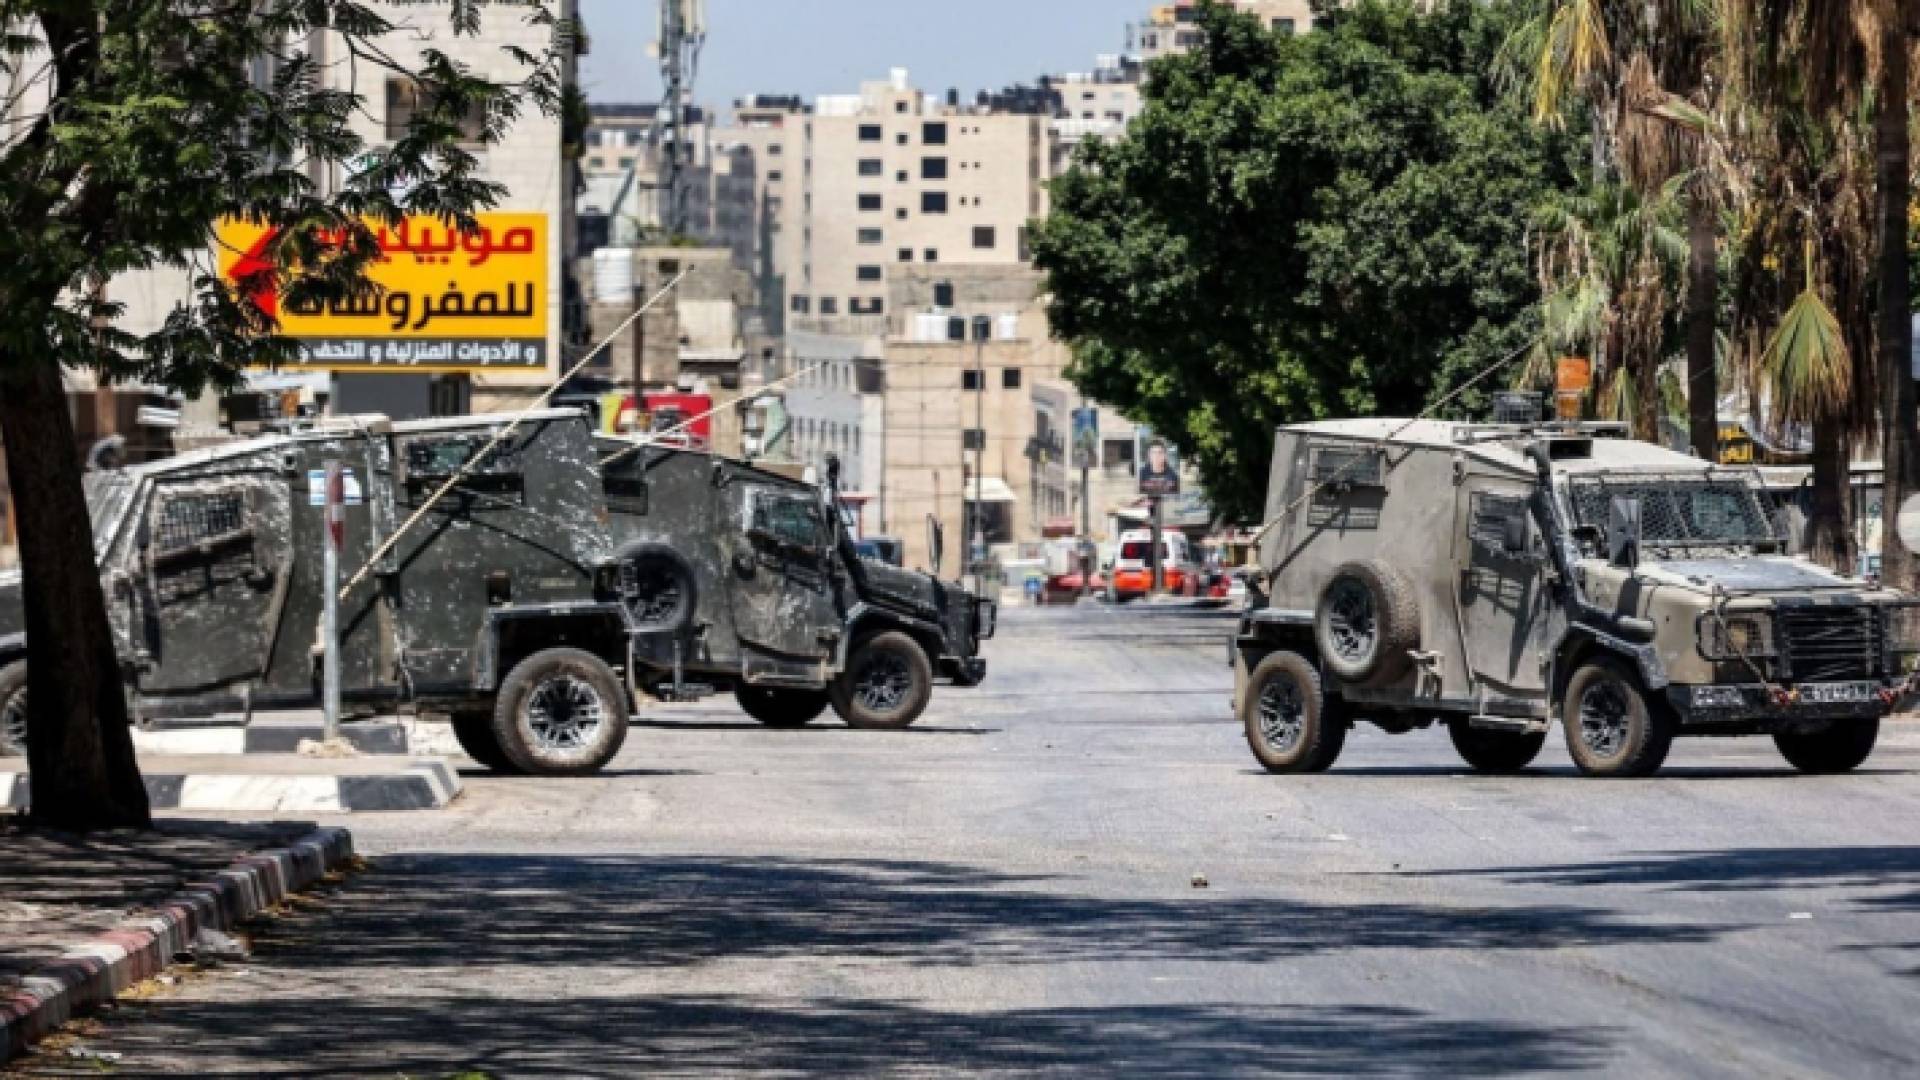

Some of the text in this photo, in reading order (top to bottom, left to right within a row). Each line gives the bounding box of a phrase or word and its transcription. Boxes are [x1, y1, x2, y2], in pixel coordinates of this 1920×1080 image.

[369, 344, 382, 365] و
[385, 339, 453, 365] المنزلية
[525, 345, 538, 364] و
